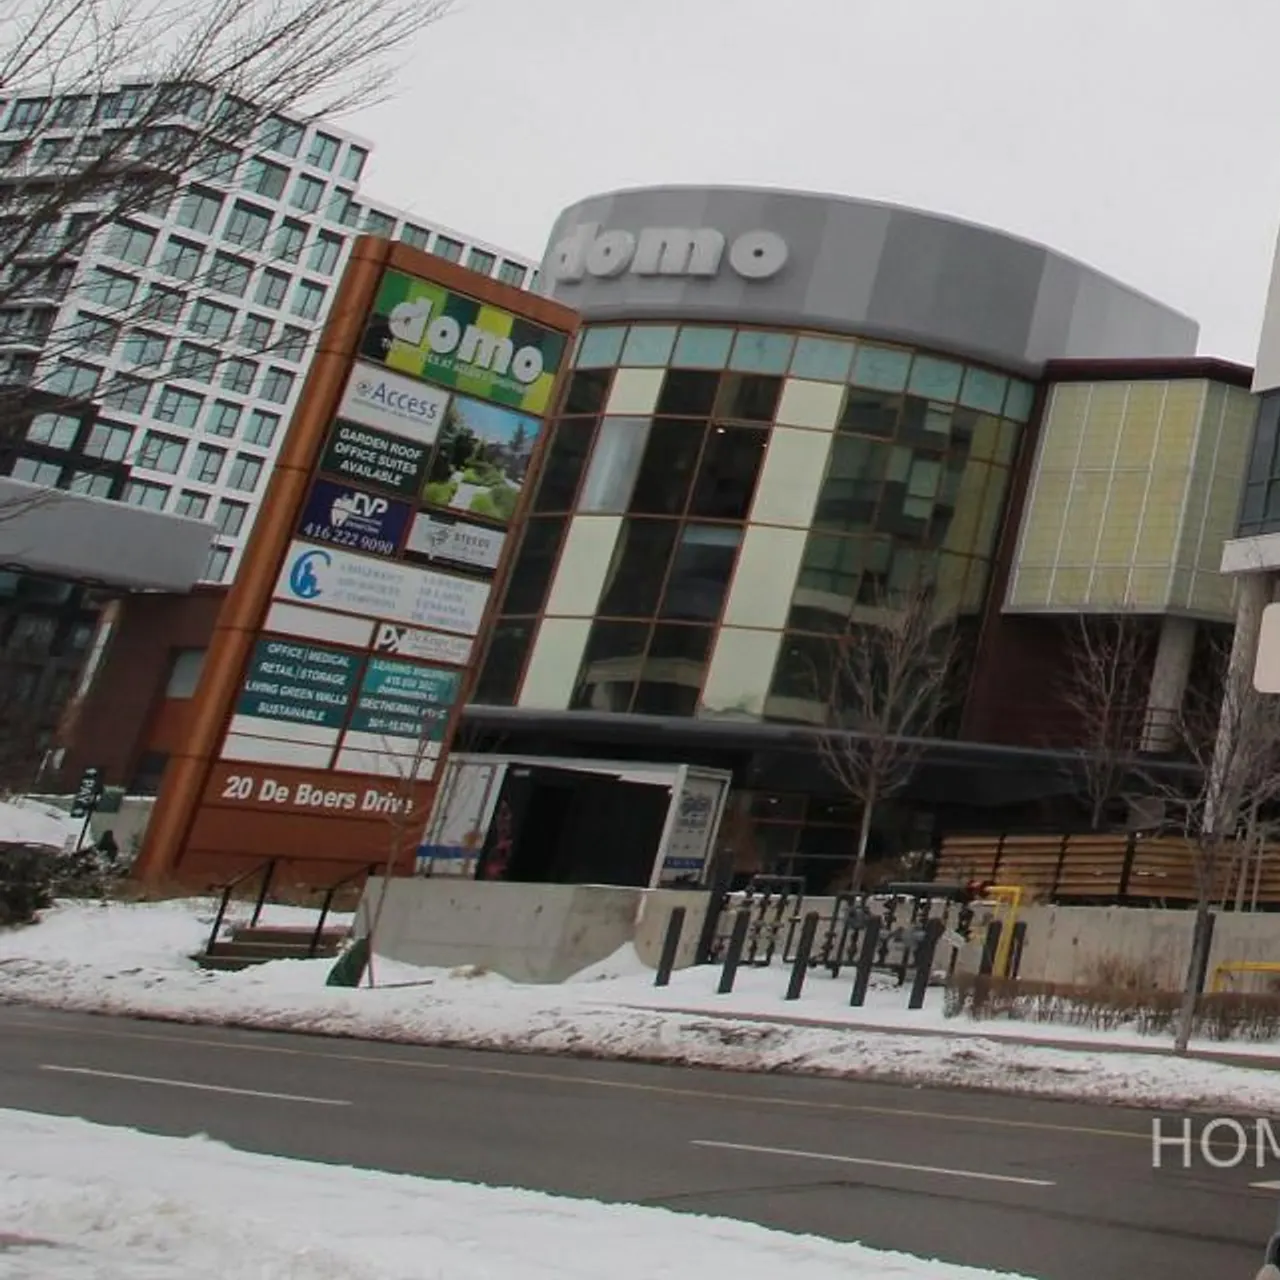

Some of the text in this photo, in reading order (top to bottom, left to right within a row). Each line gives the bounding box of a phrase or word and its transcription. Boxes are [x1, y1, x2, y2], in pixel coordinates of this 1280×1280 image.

[553, 222, 789, 280] domo
[389, 296, 544, 384] domo
[371, 382, 439, 419] Access
[334, 442, 418, 475] OFFICE SUITES
[340, 428, 423, 459] GARDEN ROOF
[340, 460, 403, 486] AVAILABLE
[304, 522, 331, 539] 416
[331, 527, 359, 547] 222
[360, 535, 394, 555] 9090
[266, 643, 349, 668] OFFICE MEDICAL
[260, 661, 348, 686] RETAIL STORAGE
[245, 680, 278, 696] LIVING
[279, 684, 314, 700] GREEN
[257, 701, 327, 721] SUSTAINABLE
[221, 775, 253, 799] 20
[258, 779, 289, 803] De
[294, 783, 357, 810] Boers
